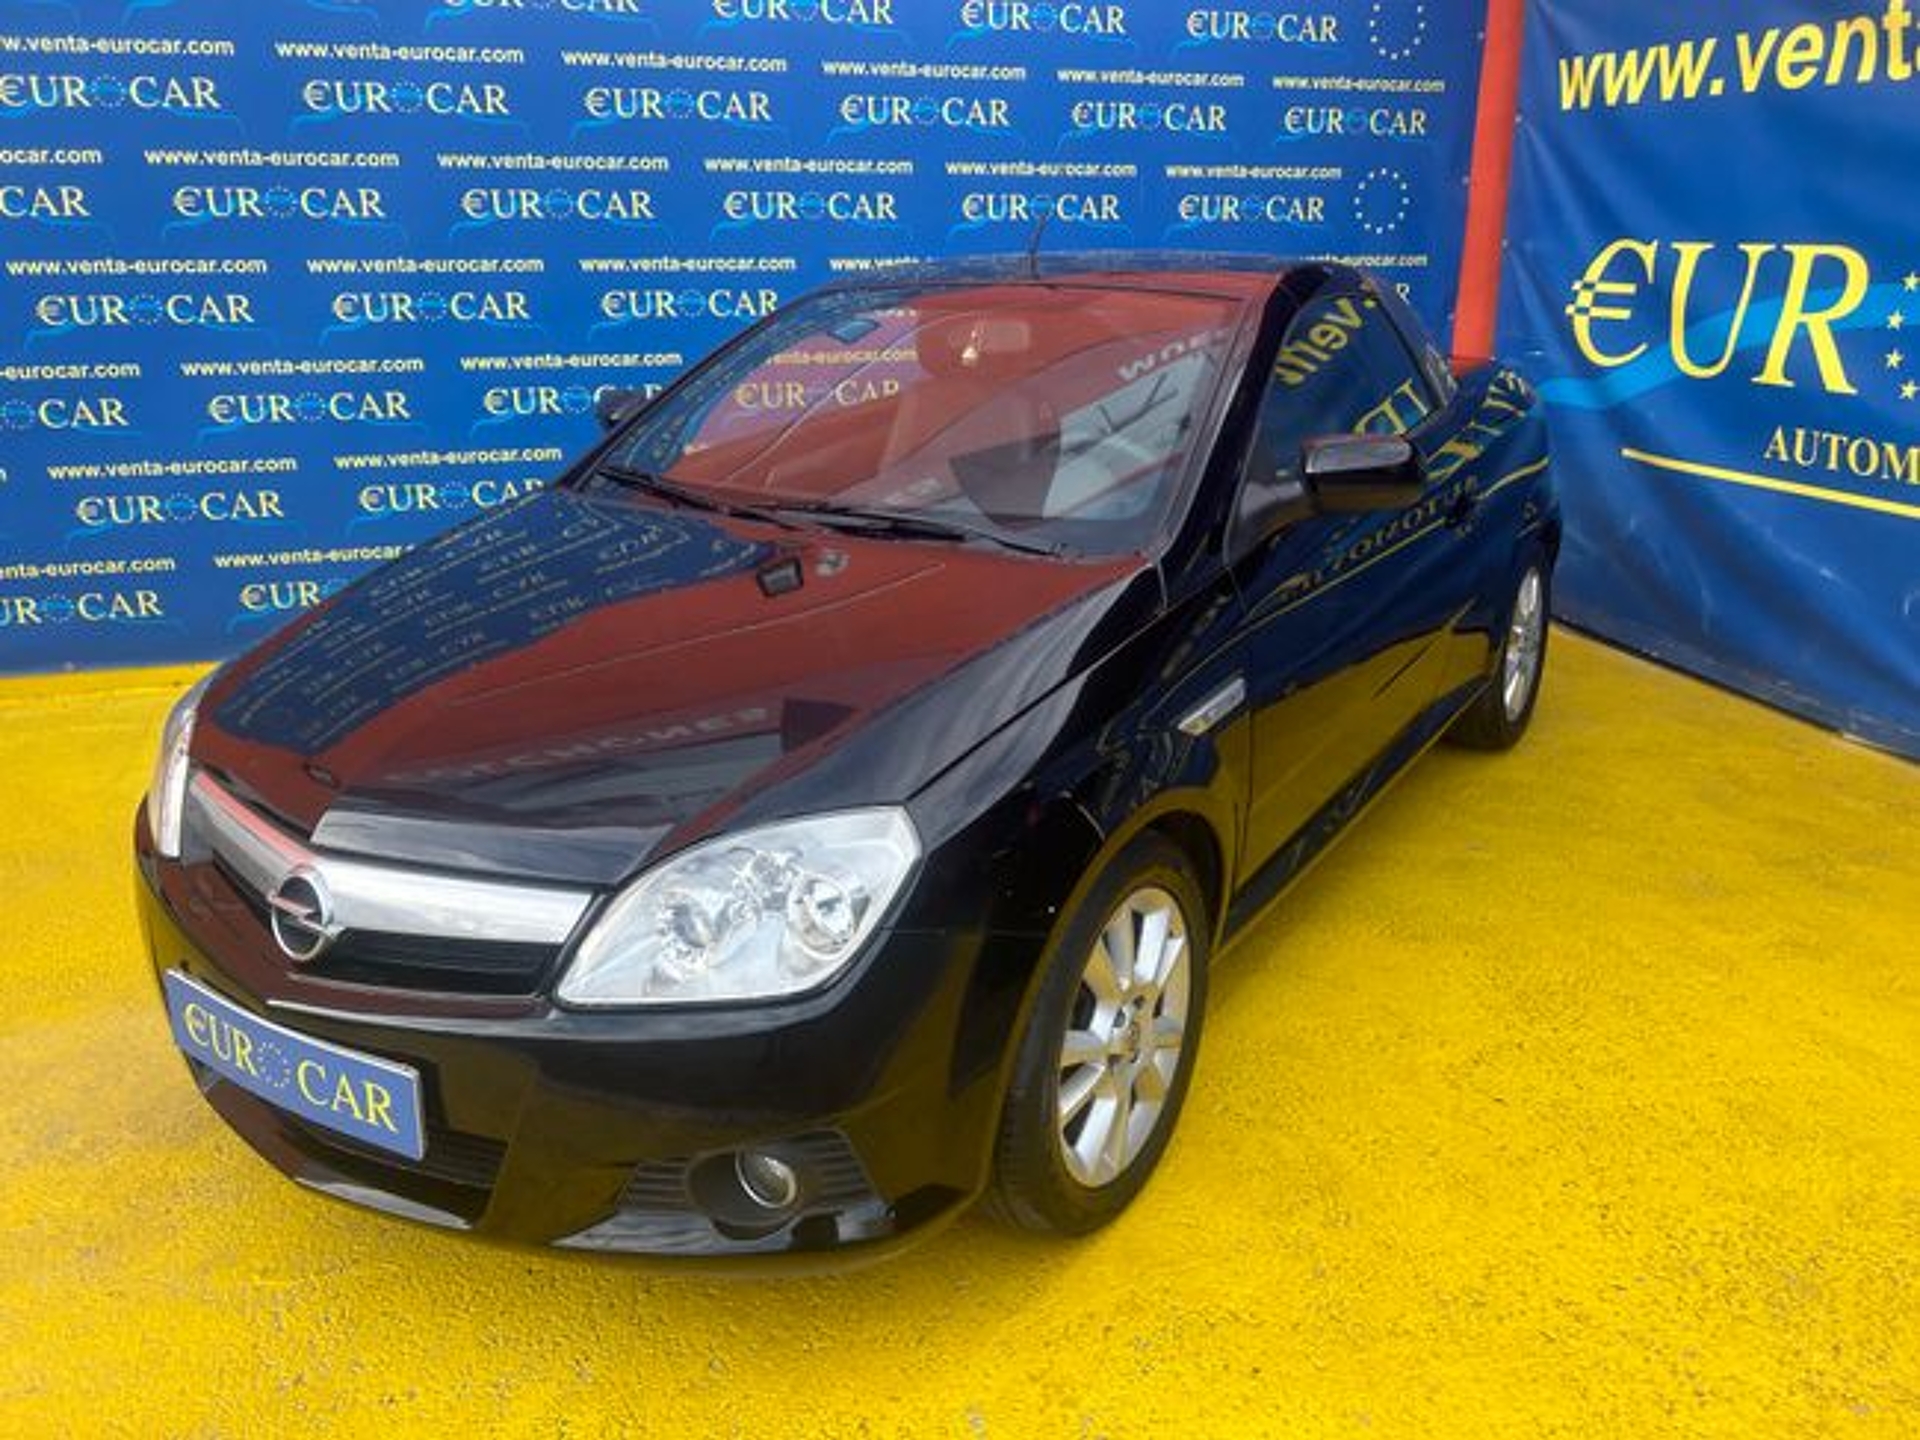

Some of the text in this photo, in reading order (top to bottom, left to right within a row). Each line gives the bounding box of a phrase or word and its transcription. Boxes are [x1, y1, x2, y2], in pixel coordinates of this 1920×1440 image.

[274, 42, 524, 63] www.venta-eurocar.com
[561, 51, 787, 72] www.venta-eurocar.com
[1559, 0, 1920, 110] www.vent
[822, 61, 1027, 81] www.venta-eurocar.com
[1057, 69, 1244, 87] www.venta-eurocar.com
[1273, 76, 1445, 92] www.venta-eurocar.com
[144, 149, 399, 167] www.venta-eurocar.com
[437, 153, 669, 171] www.venta-eurocar.com
[704, 157, 913, 174] www.venta-eurocar.com
[945, 161, 1137, 178] www.venta-eurocar.com
[1165, 165, 1342, 180] www.venta-eurocar.com
[5, 258, 268, 276] www.venta-eurocar.com
[306, 256, 544, 273] www.venta-eurocar.com
[579, 255, 797, 272] www.venta-eurocar.com
[180, 358, 425, 376] www.venta-eurocar.com
[460, 353, 682, 371] www.venta-eurocar.com
[333, 448, 562, 469] www.venta-eurocar.com
[1763, 425, 1920, 485] AUTOM
[47, 457, 298, 480] www.venta-eurocar.com
